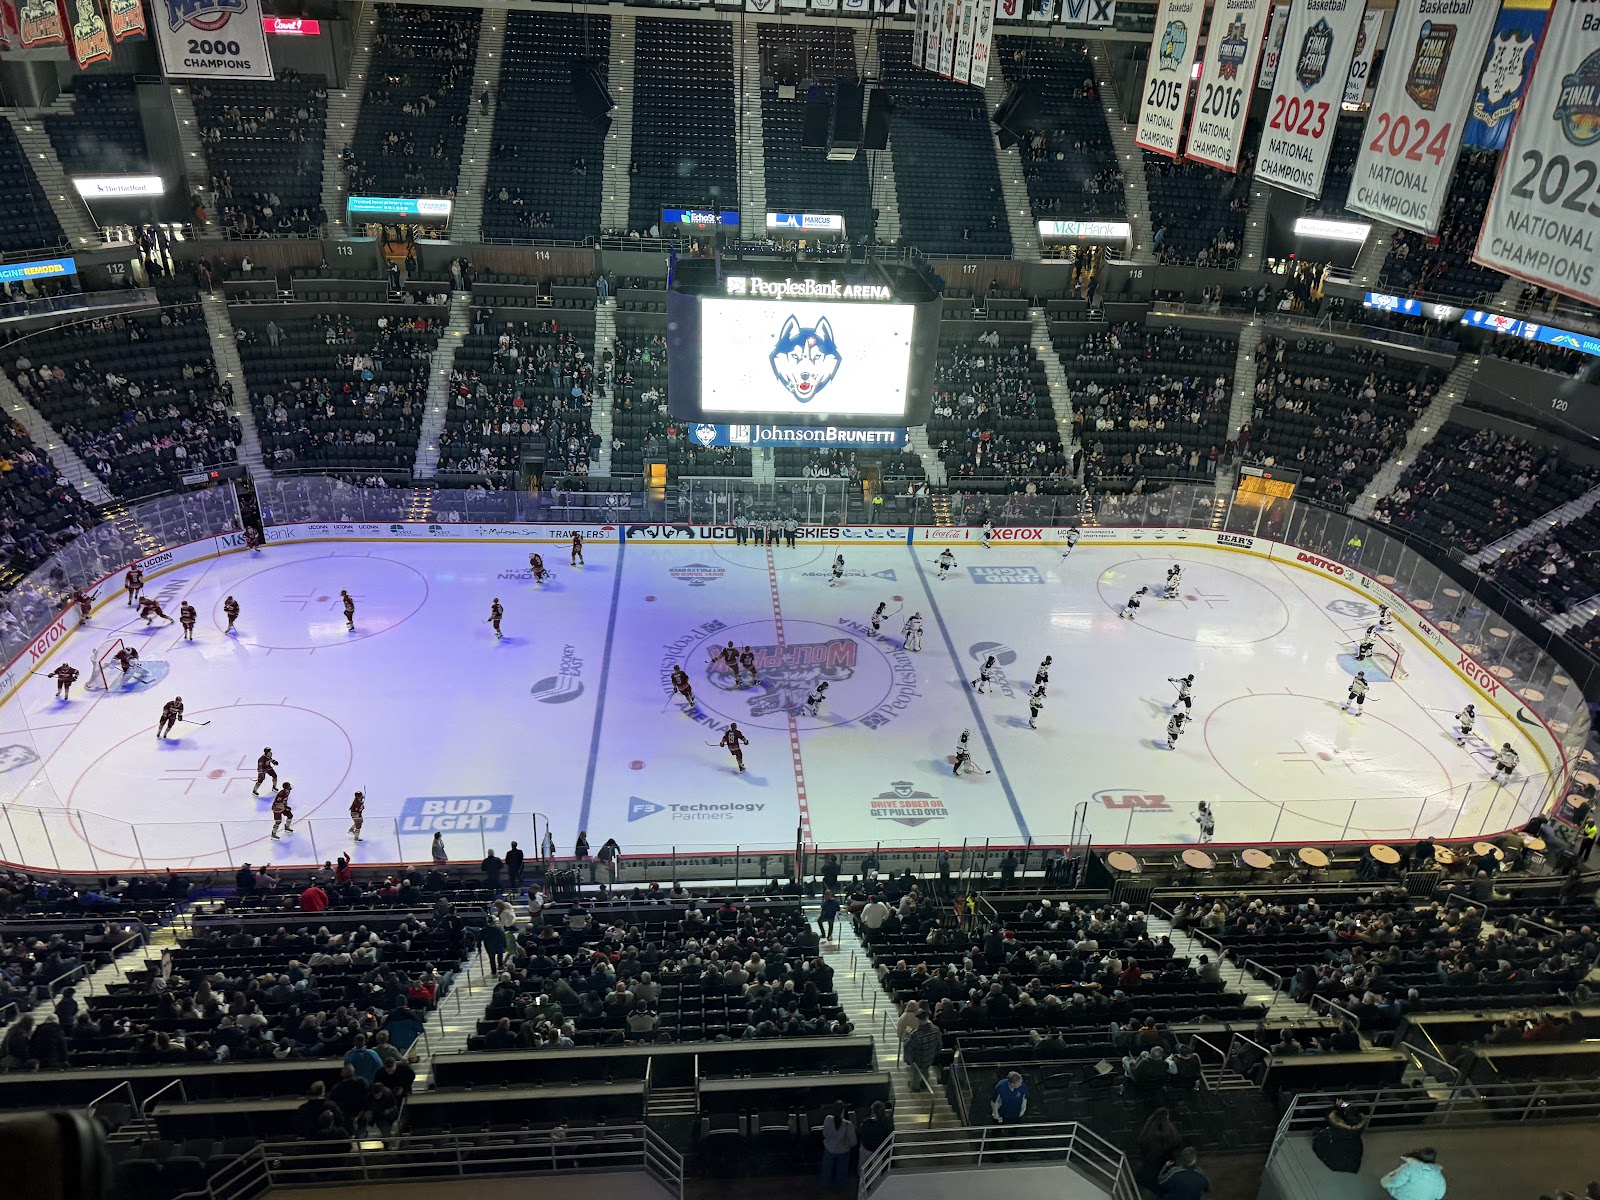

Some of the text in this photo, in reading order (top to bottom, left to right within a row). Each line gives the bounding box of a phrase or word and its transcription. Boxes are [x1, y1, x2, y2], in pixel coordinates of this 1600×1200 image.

[1168, 2, 1193, 12] Basketball
[1227, 0, 1256, 9] Basketball
[1307, 0, 1346, 11] Basketball
[1419, 0, 1473, 14] Basketball
[187, 39, 240, 56] 2000
[1306, 37, 1328, 52] FINAL
[1419, 40, 1447, 57] FINAL
[184, 58, 251, 69] CHAMPIONS
[1414, 57, 1441, 75] FOUR
[1147, 78, 1182, 111] 2015
[1201, 83, 1242, 120] 2016
[1560, 85, 1595, 107] FINAL
[1146, 113, 1173, 130] NATIONAL
[1269, 94, 1330, 138] 2023
[1141, 129, 1173, 149] CHAMPIONS
[1198, 122, 1231, 141] NATIONAL
[1369, 112, 1451, 166] 2024
[1193, 140, 1232, 161] CHAMPIONS
[1268, 138, 1314, 163] NATIONAL
[1261, 159, 1314, 187] CHAMPIONS
[1368, 163, 1428, 193] NATIONAL
[118, 184, 146, 192] Hartford
[1358, 187, 1428, 221] CHAMPIONS
[805, 216, 831, 224] MARCUS
[1053, 221, 1115, 235] M&T Bank
[1506, 210, 1593, 252] NATIONAL
[337, 246, 353, 255] 113
[534, 250, 550, 260] 114
[106, 263, 125, 274] 112
[963, 265, 977, 274] 117
[1491, 238, 1594, 286] CHAMPIONS
[1129, 270, 1143, 278] 118
[750, 277, 891, 299] PeoplesBank ARENA
[1551, 398, 1568, 412] 120
[221, 533, 245, 549] M&
[775, 527, 840, 539] SKIES
[991, 528, 1043, 540] xerox
[1217, 534, 1254, 546] BEAR'S
[143, 552, 173, 568] UCONN
[1296, 552, 1344, 576] DATTCO
[1418, 621, 1432, 635] LAZ
[29, 618, 67, 663] xerox
[559, 644, 575, 675] HOCKEY
[727, 651, 733, 660] 7
[570, 657, 583, 676] EAST
[1456, 653, 1500, 698] xerox
[421, 799, 492, 815] BUD
[668, 802, 765, 811] Technology
[899, 800, 929, 808] SOBER
[931, 800, 944, 808] OR
[1101, 795, 1171, 809] LAZ
[672, 812, 733, 821] Partners
[870, 808, 948, 816] GET PULLED OVER
[402, 814, 504, 831] LIGHT
